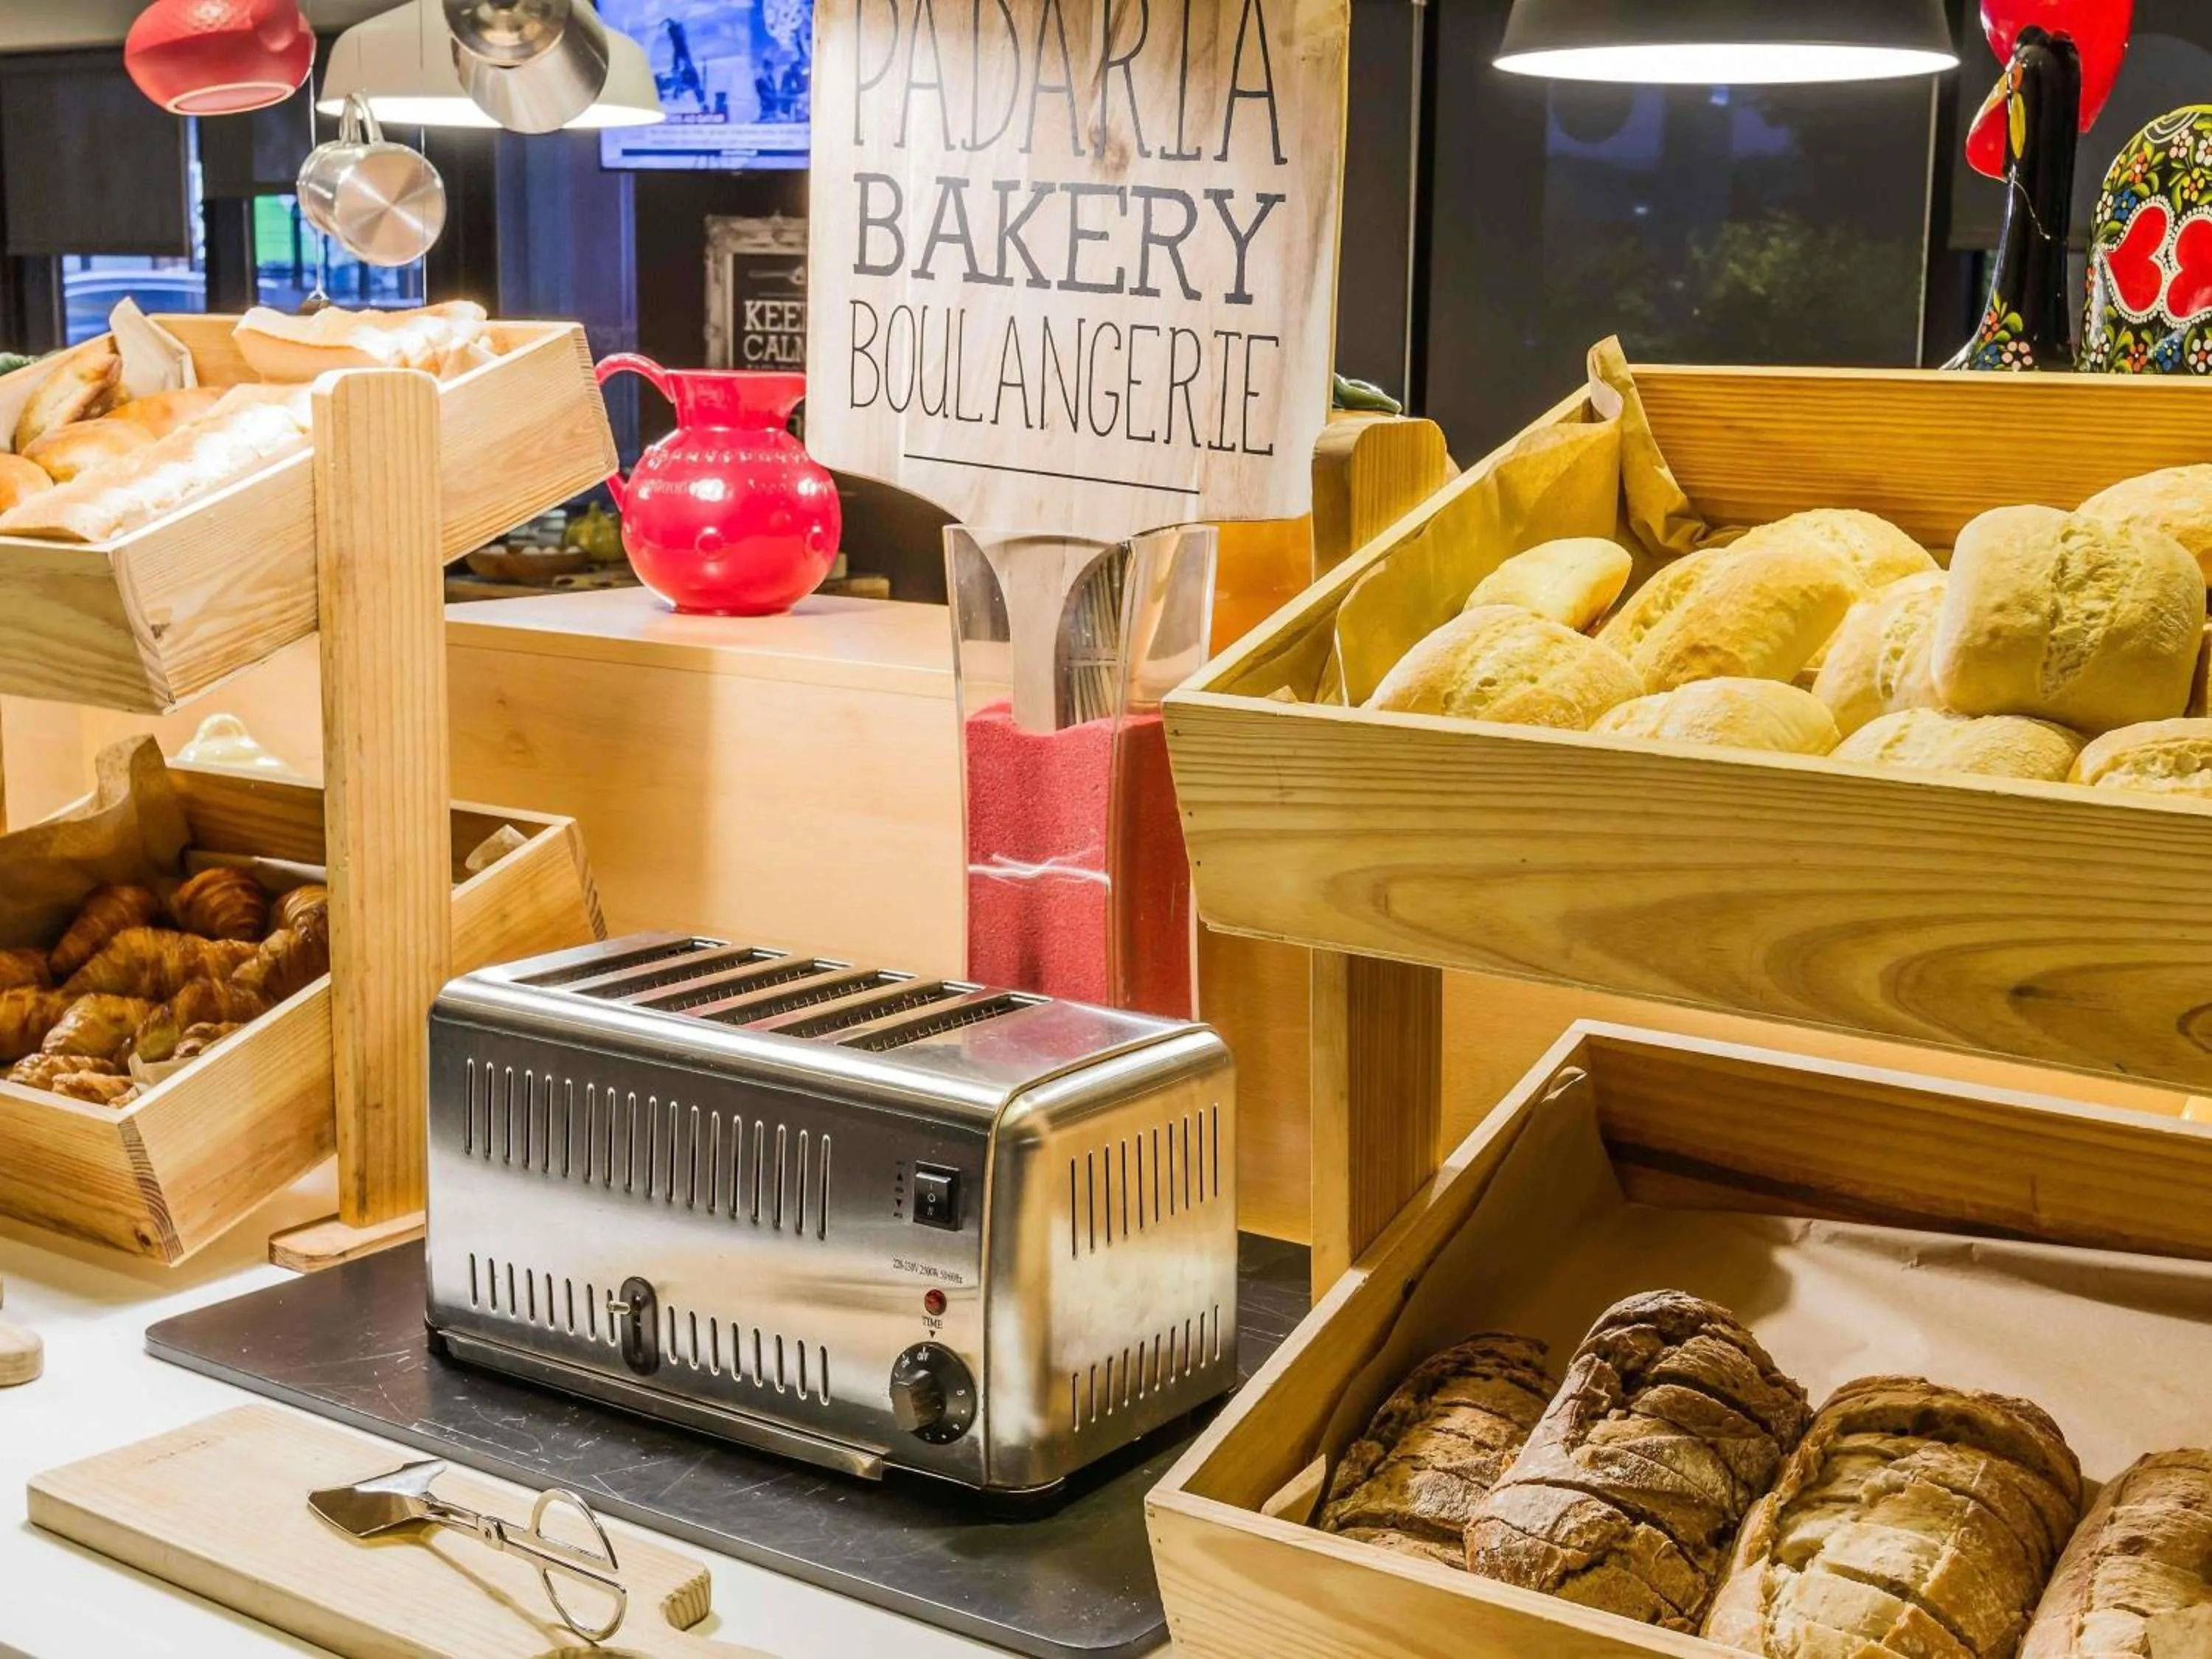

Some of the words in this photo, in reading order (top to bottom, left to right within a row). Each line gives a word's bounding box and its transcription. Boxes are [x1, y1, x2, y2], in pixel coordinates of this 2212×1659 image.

[853, 0, 1288, 165] PADARIA
[853, 173, 1287, 305] BAKERY
[849, 300, 1279, 456] BOULANGERIE
[922, 1315, 943, 1329] TIME
